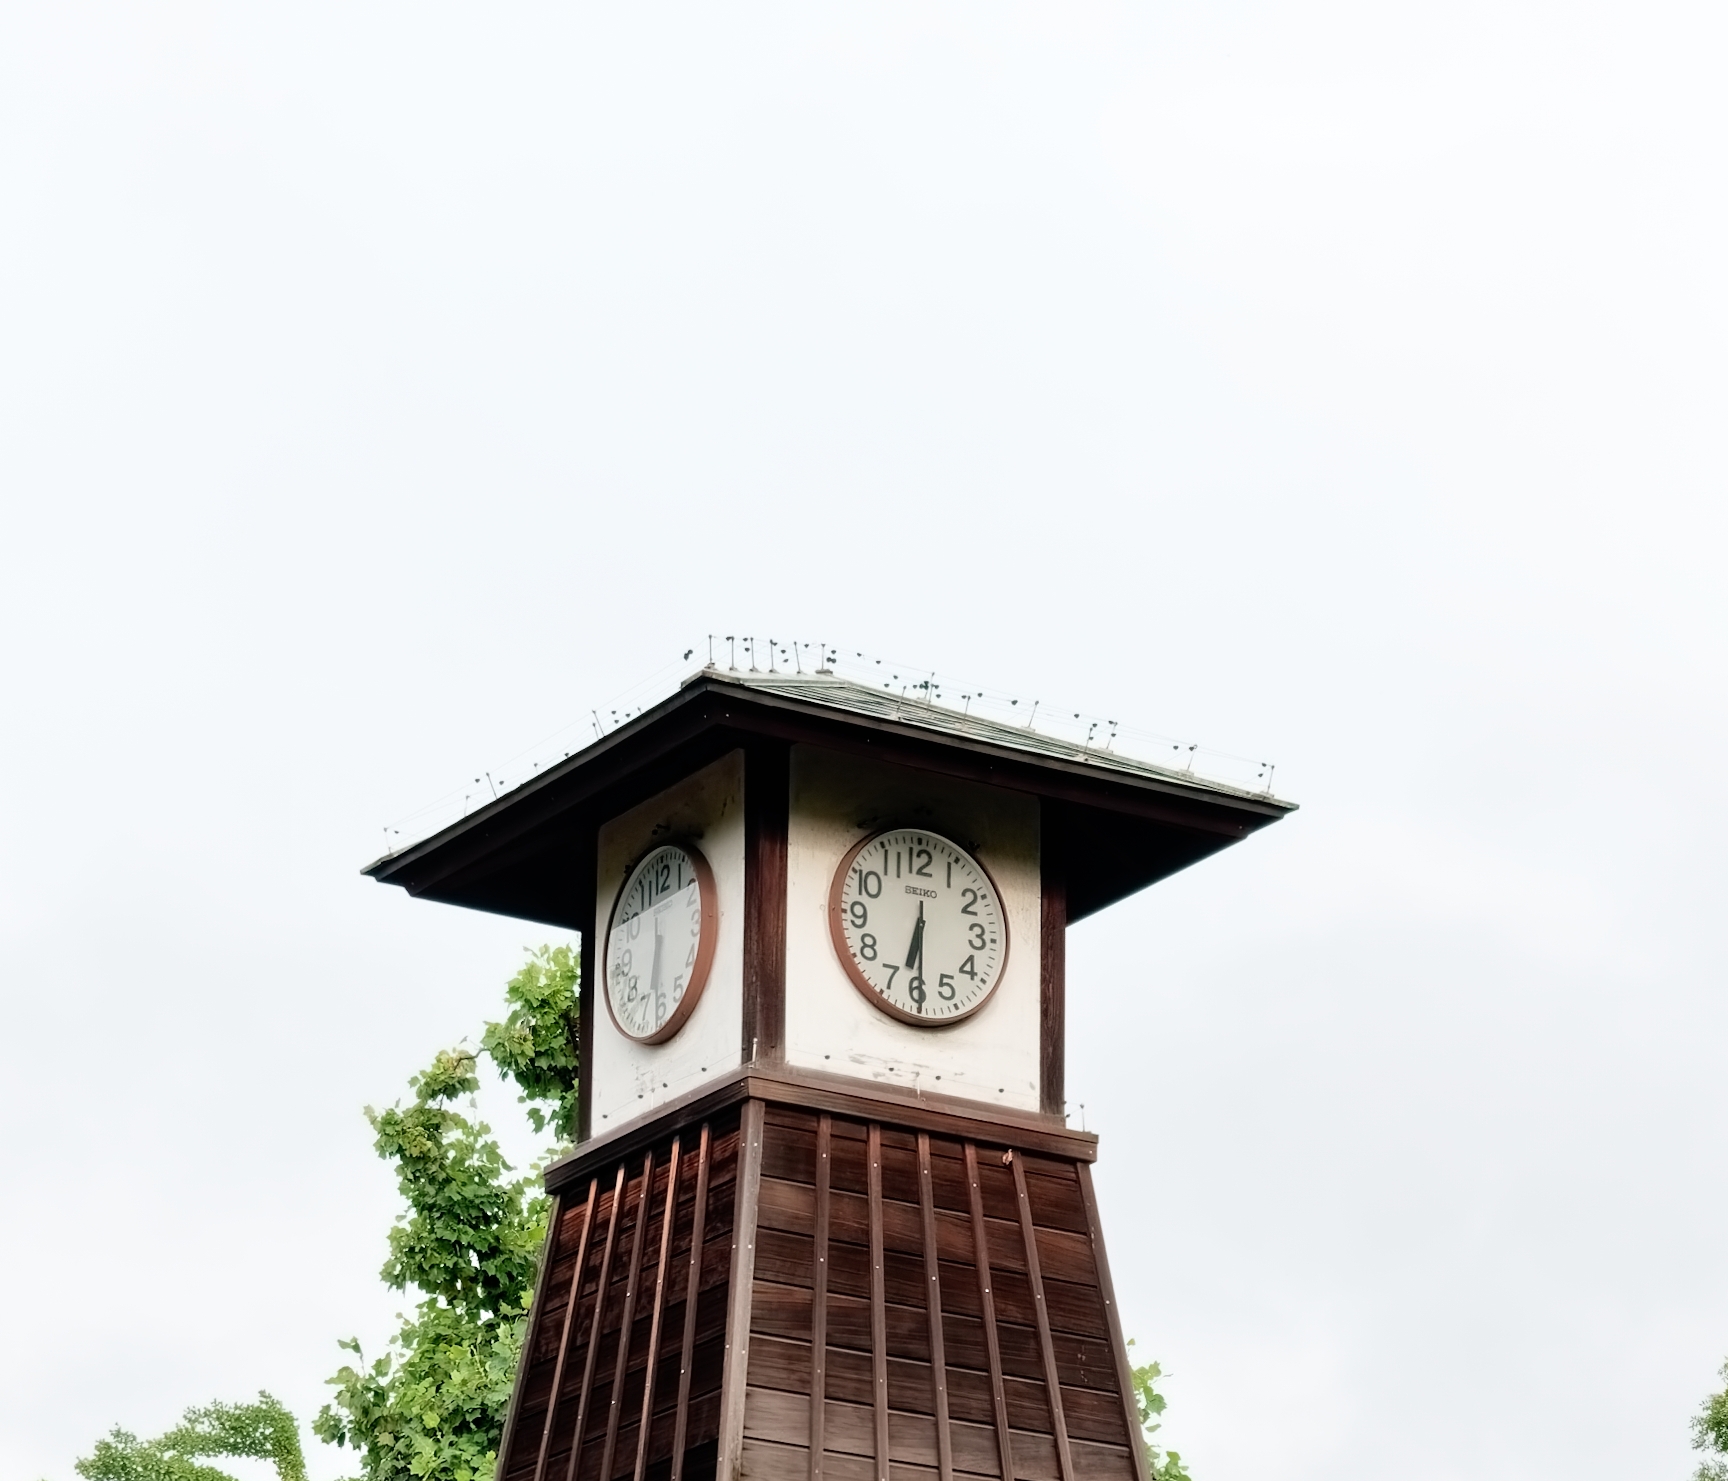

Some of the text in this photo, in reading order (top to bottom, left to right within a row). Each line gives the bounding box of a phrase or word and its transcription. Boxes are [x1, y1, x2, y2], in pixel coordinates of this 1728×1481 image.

[884, 849, 901, 878] 11
[909, 847, 933, 878] 12
[946, 861, 952, 888] 1
[656, 864, 671, 896] 12
[858, 869, 882, 899] 10
[904, 885, 938, 899] SEIKO
[850, 901, 868, 929] 9
[961, 888, 979, 916] 2
[860, 933, 878, 961] 8
[968, 923, 987, 951] 3
[882, 963, 900, 990] 7
[958, 954, 978, 981] 4
[627, 975, 638, 1003] 8
[673, 974, 684, 1003] 5
[908, 976, 927, 1004] 6
[937, 973, 956, 1001] 5
